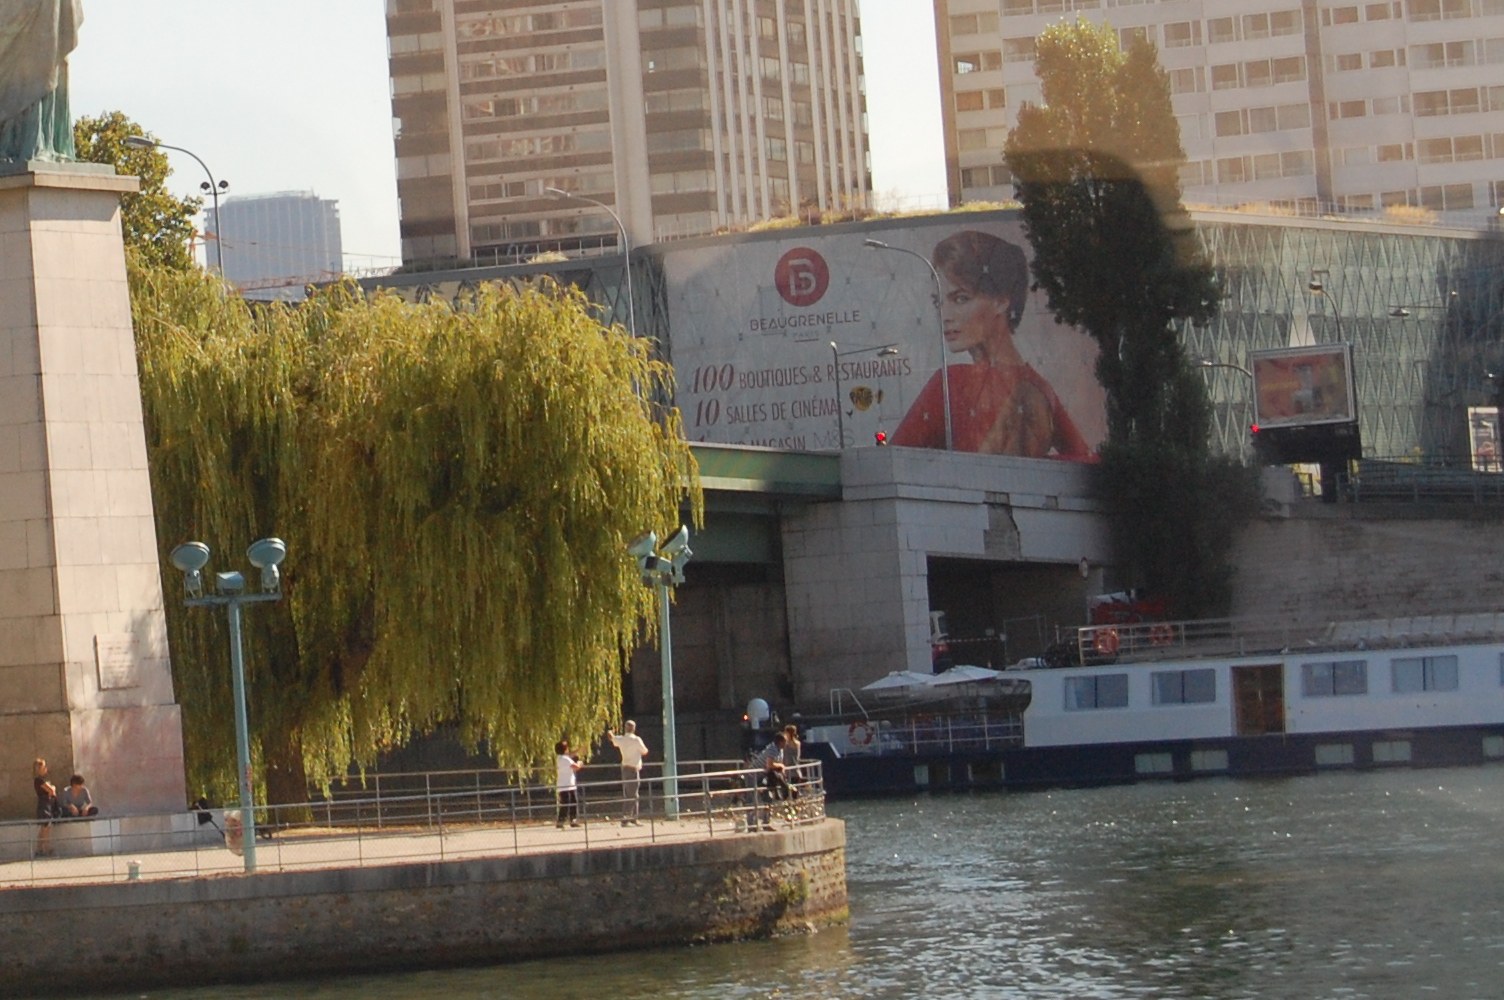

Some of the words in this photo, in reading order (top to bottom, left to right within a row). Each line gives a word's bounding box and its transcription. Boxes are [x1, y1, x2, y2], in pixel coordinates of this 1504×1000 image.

[750, 310, 861, 331] BEAUGRENELLE
[694, 363, 734, 394] 100
[739, 366, 808, 389] BOUTIQUES
[813, 365, 822, 383] &
[696, 398, 720, 428] 10
[726, 403, 768, 424] SALLES
[771, 402, 786, 421] DE
[791, 395, 838, 419] CINÉMA
